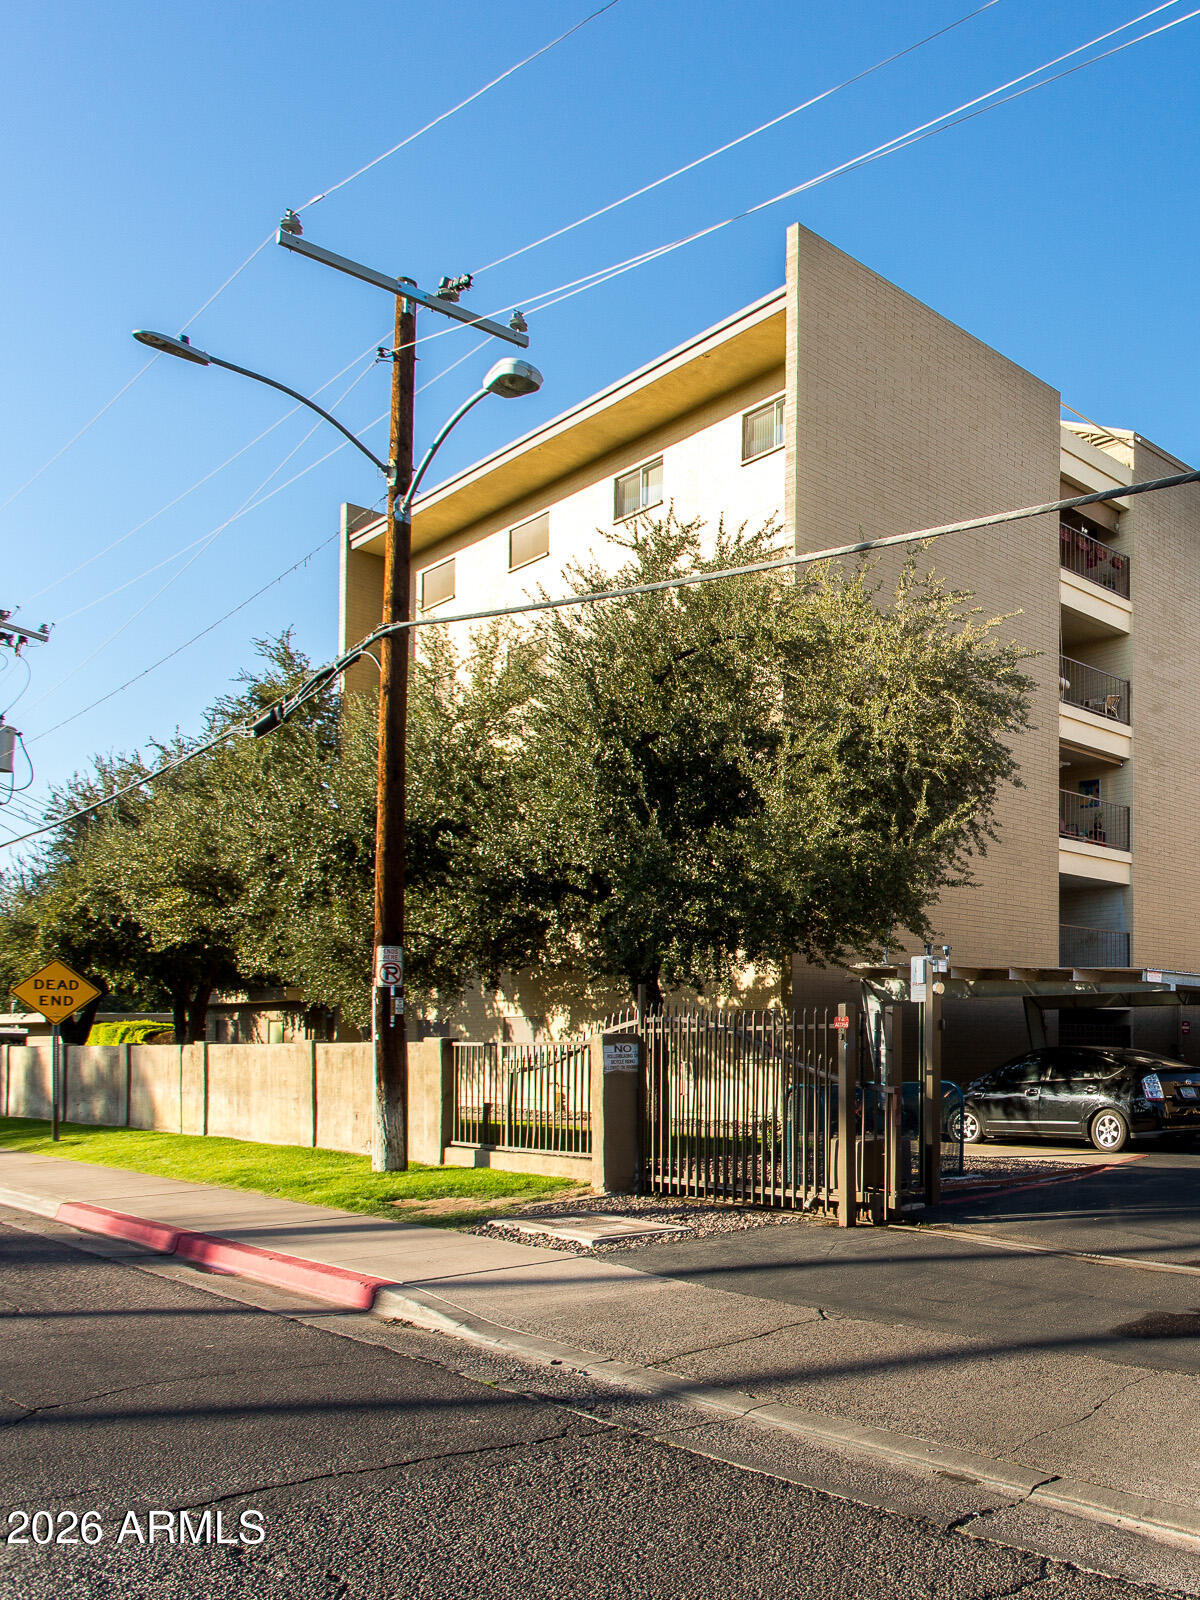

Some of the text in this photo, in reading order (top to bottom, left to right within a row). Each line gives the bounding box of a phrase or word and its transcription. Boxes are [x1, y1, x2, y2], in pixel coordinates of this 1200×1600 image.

[33, 979, 79, 990] DEAD
[39, 995, 74, 1006] END
[614, 1044, 632, 1053] NO
